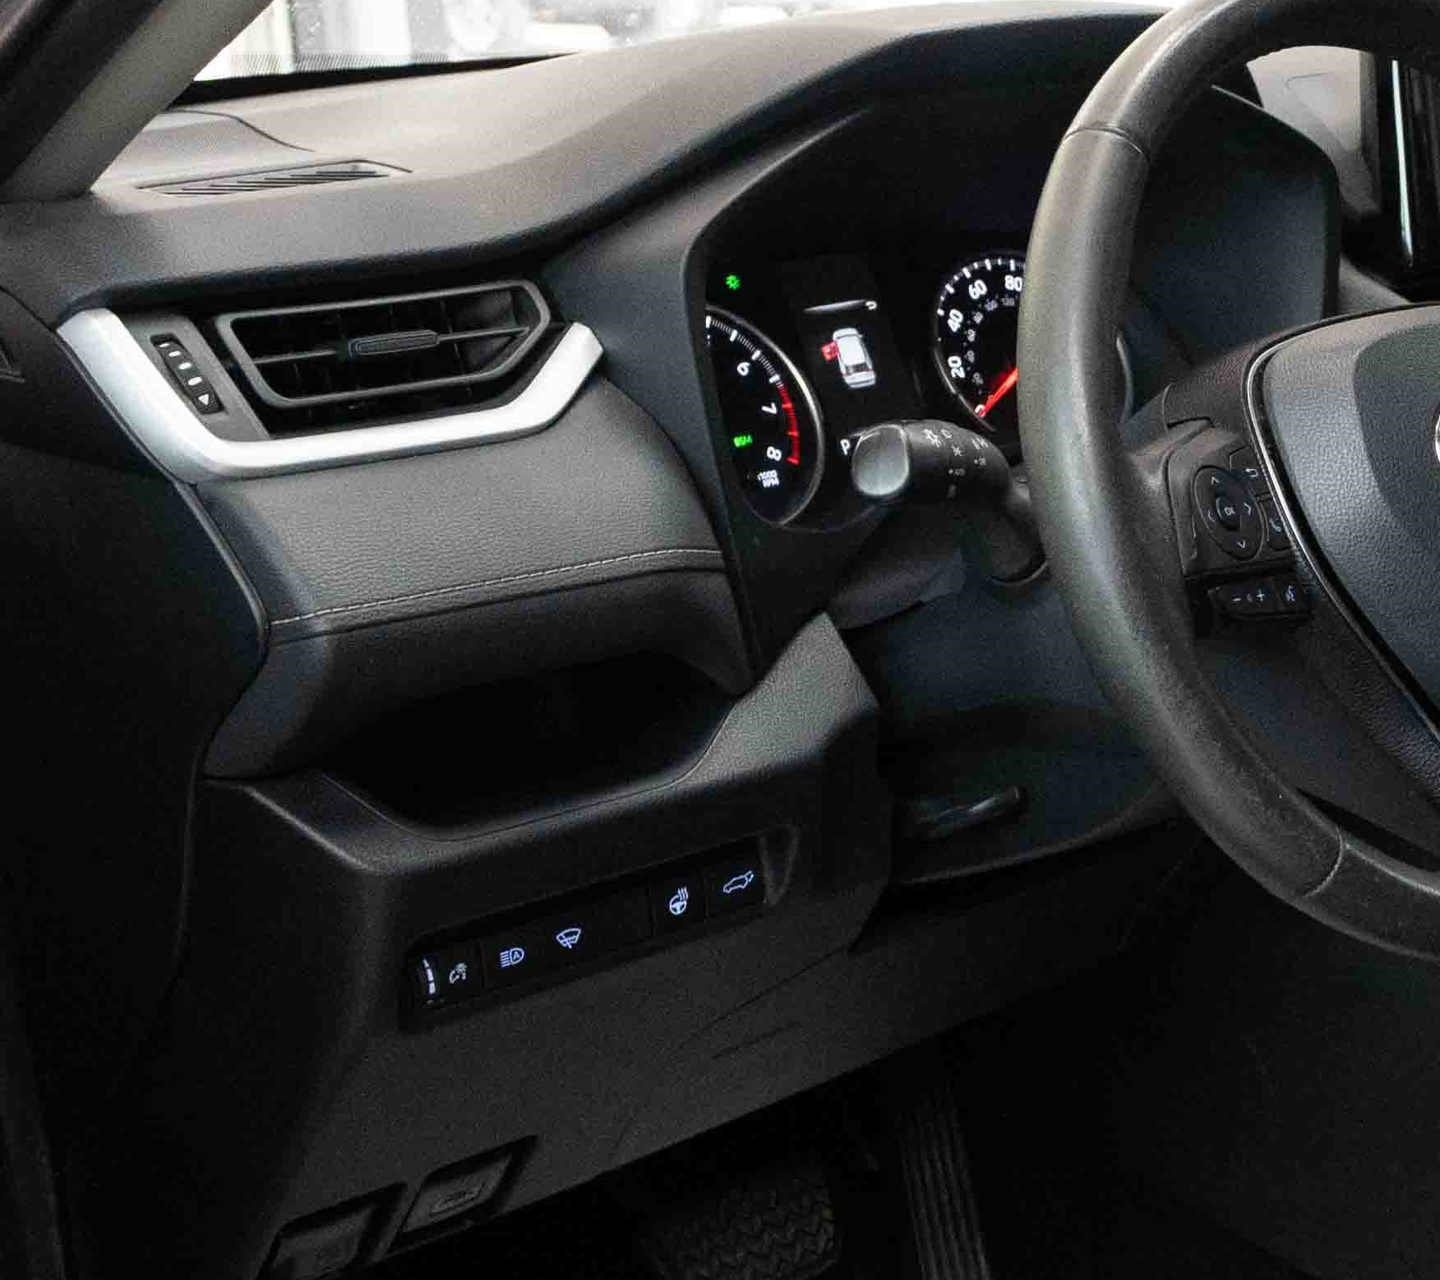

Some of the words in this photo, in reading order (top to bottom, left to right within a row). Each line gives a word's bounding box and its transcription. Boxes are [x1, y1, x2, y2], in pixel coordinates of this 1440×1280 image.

[968, 279, 988, 300] 60
[1004, 274, 1023, 292] 80
[947, 308, 964, 333] 40
[736, 361, 751, 376] 6
[947, 355, 965, 378] 20
[761, 402, 778, 415] 7
[766, 445, 782, 461] 8
[839, 438, 851, 456] P
